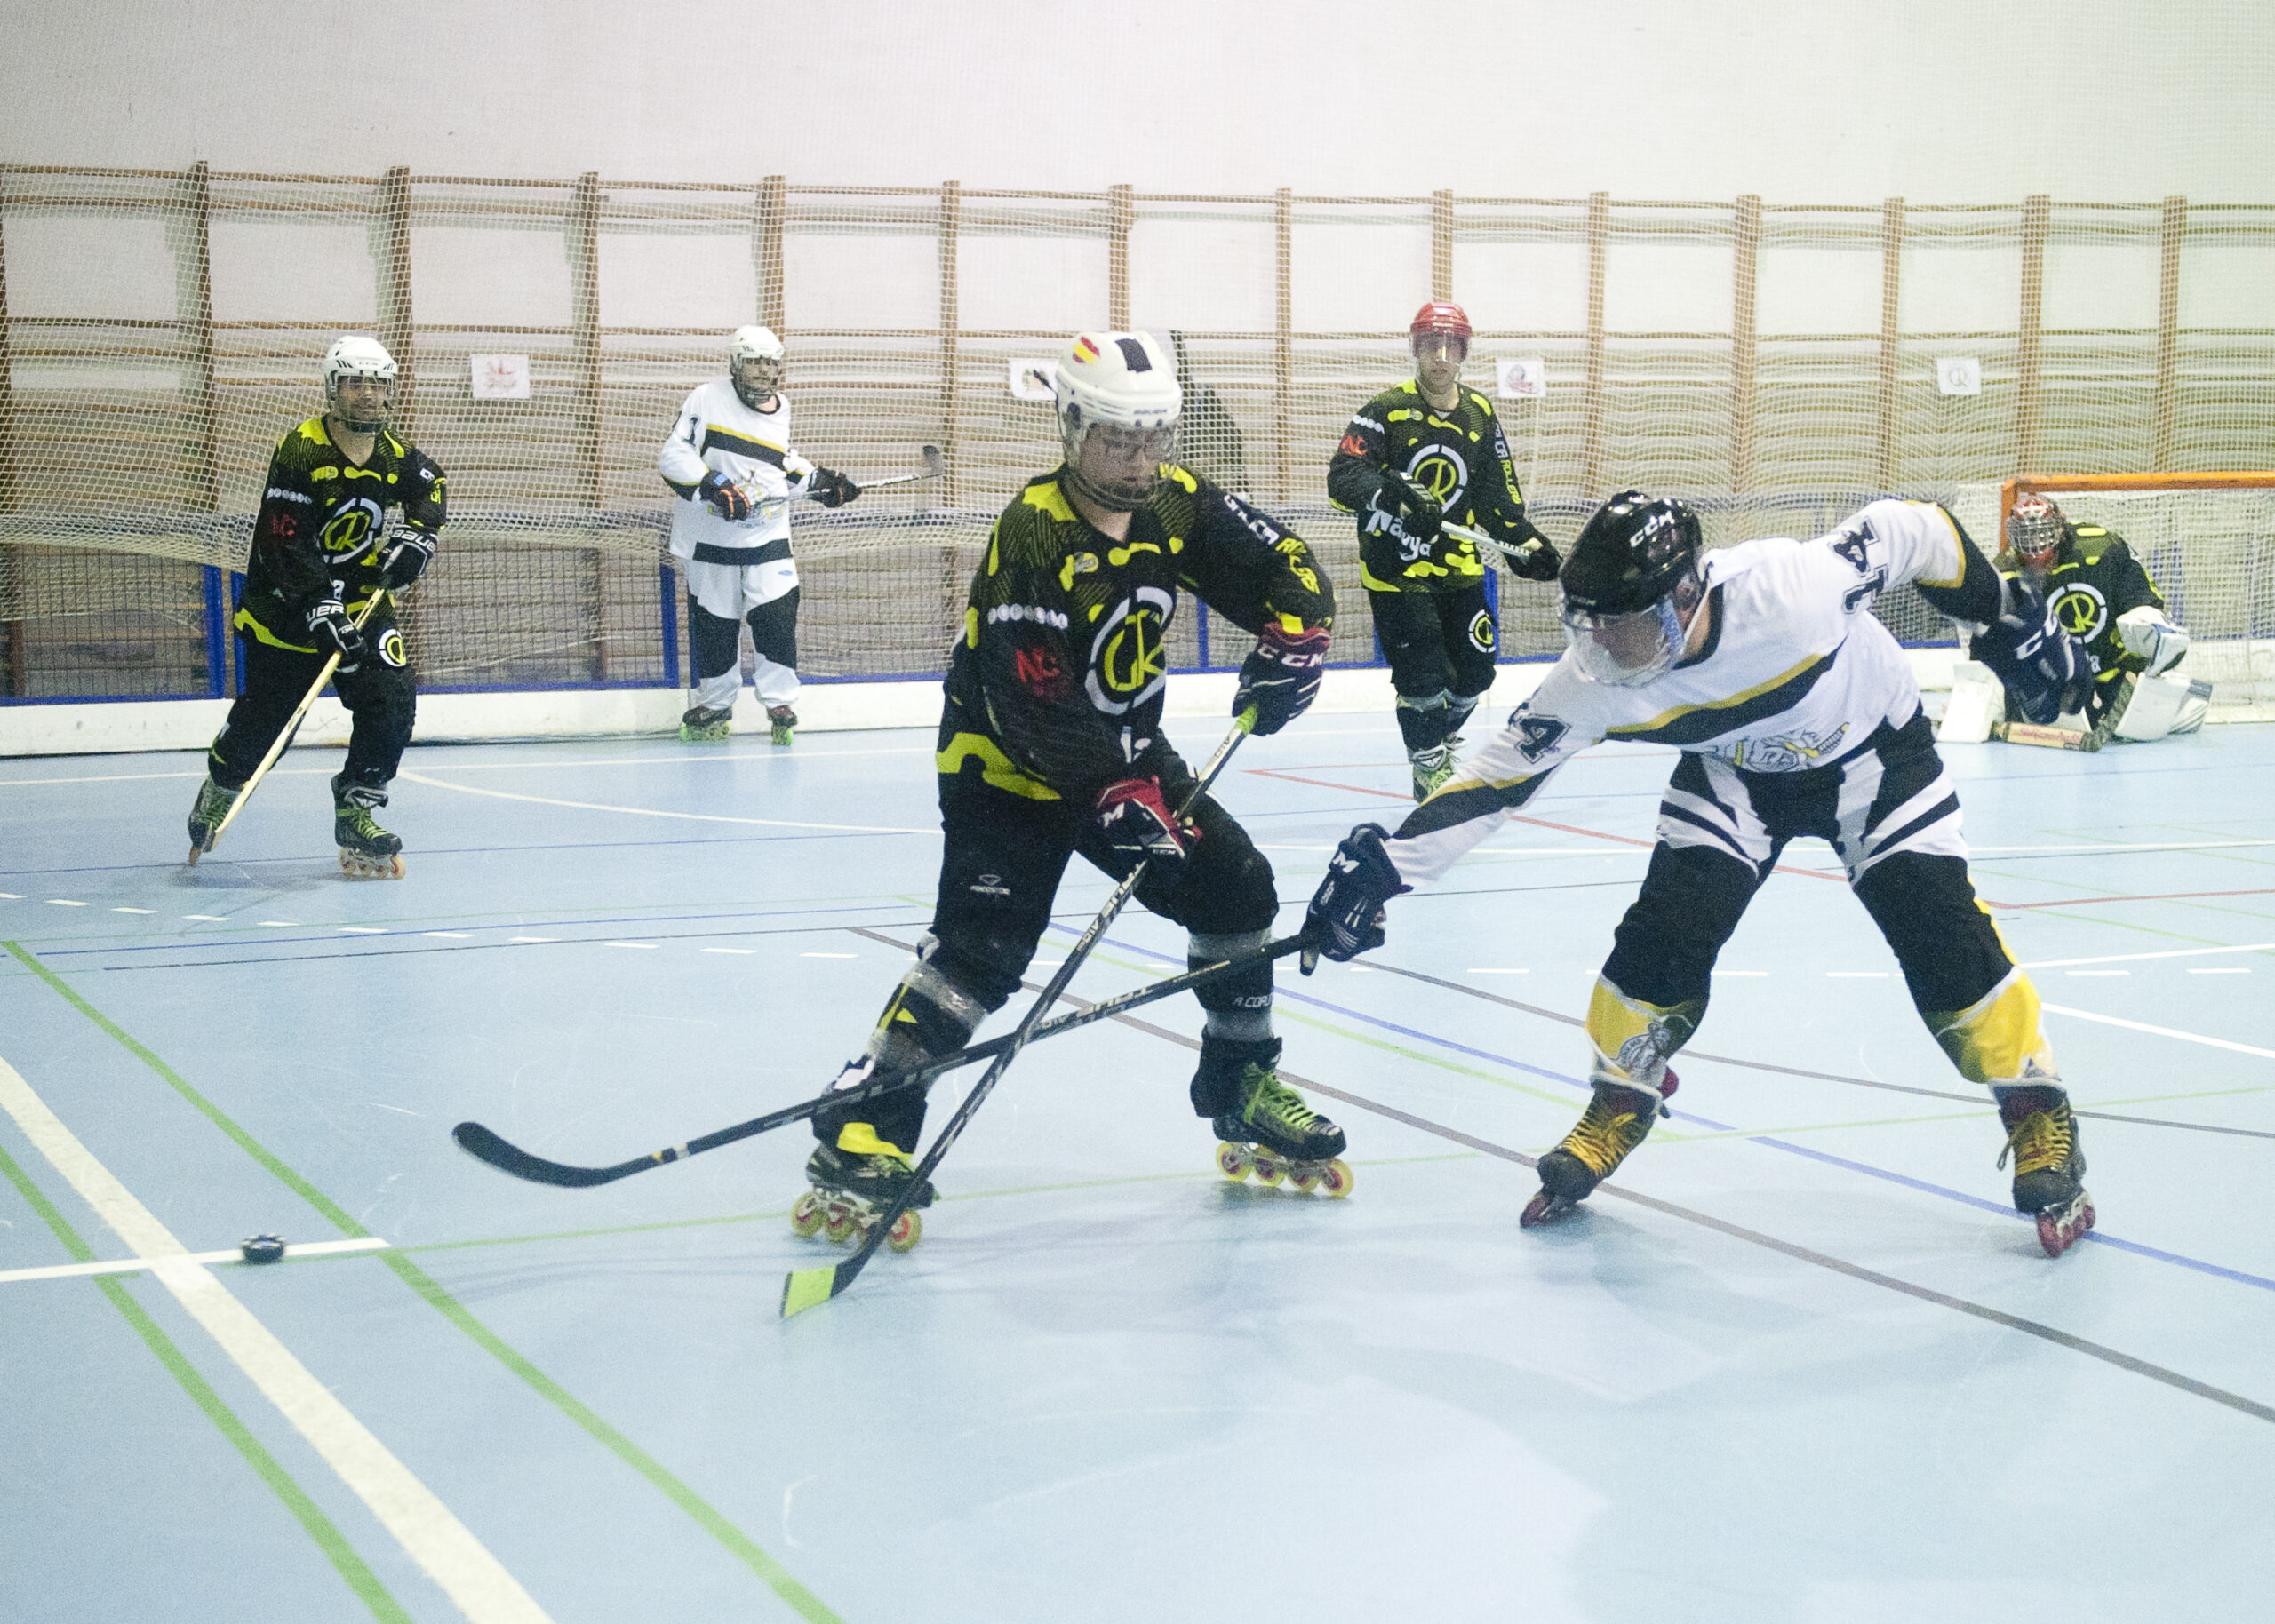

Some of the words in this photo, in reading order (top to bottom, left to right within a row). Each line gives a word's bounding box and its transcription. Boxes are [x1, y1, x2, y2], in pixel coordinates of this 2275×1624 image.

[391, 529, 435, 553] BAUE
[1629, 510, 1676, 548] CCM
[306, 603, 345, 623] UER
[1257, 644, 1325, 668] CCM
[1244, 992, 1273, 1008] CORU
